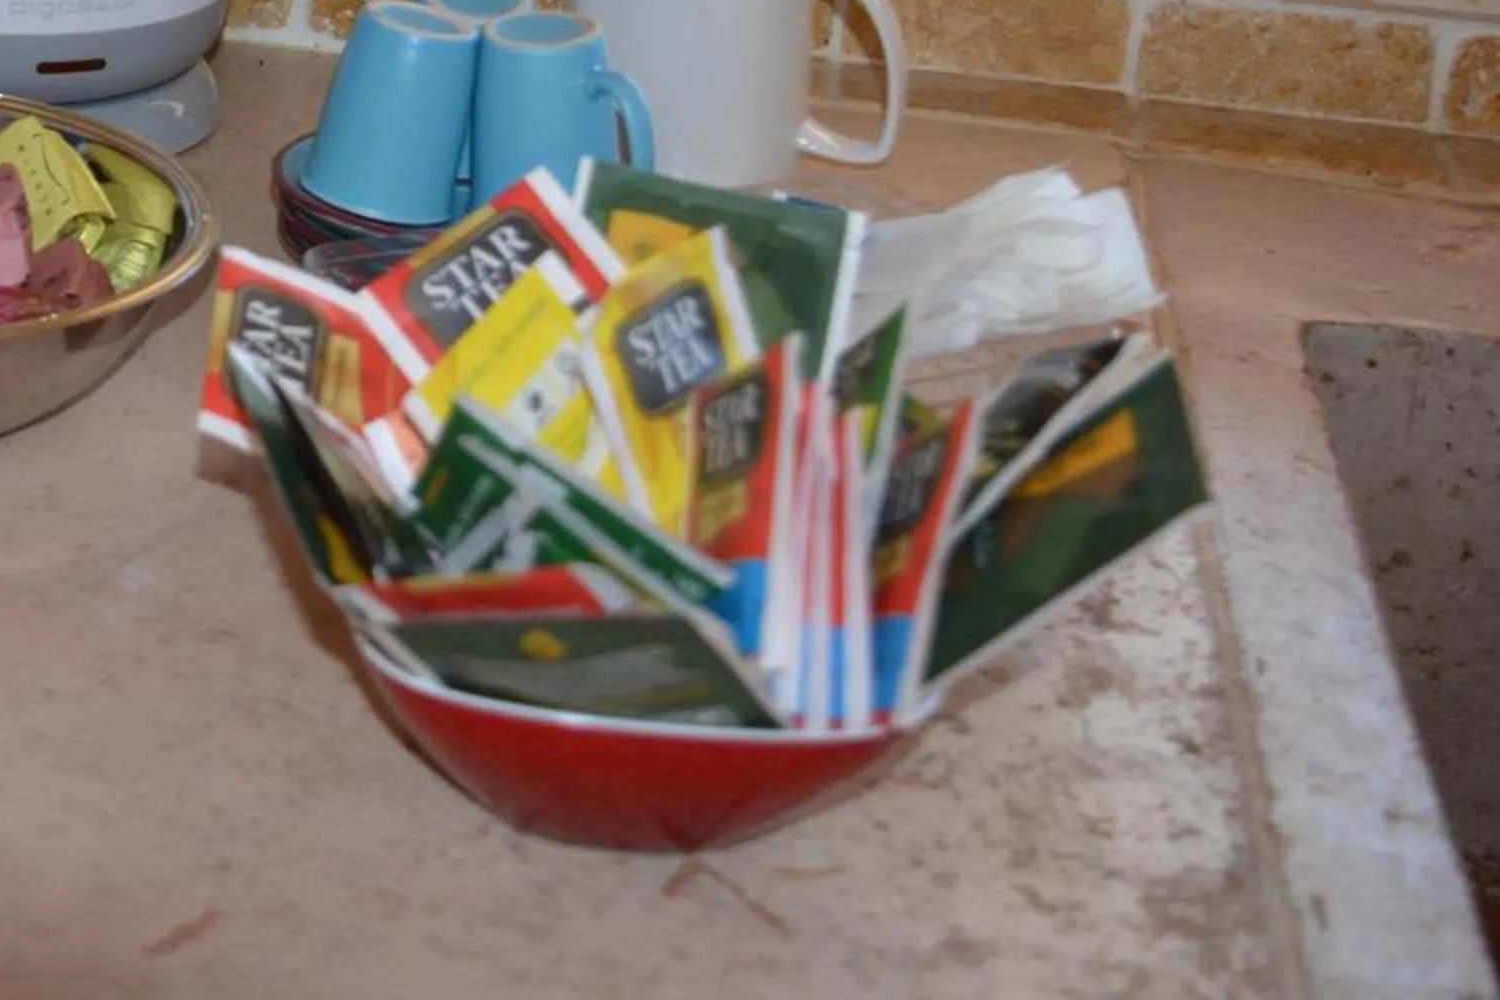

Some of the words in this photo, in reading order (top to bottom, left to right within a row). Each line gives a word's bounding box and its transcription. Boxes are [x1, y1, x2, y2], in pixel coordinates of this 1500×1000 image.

[420, 225, 533, 311] STAR
[625, 295, 707, 364] STAR
[649, 334, 715, 394] TEA
